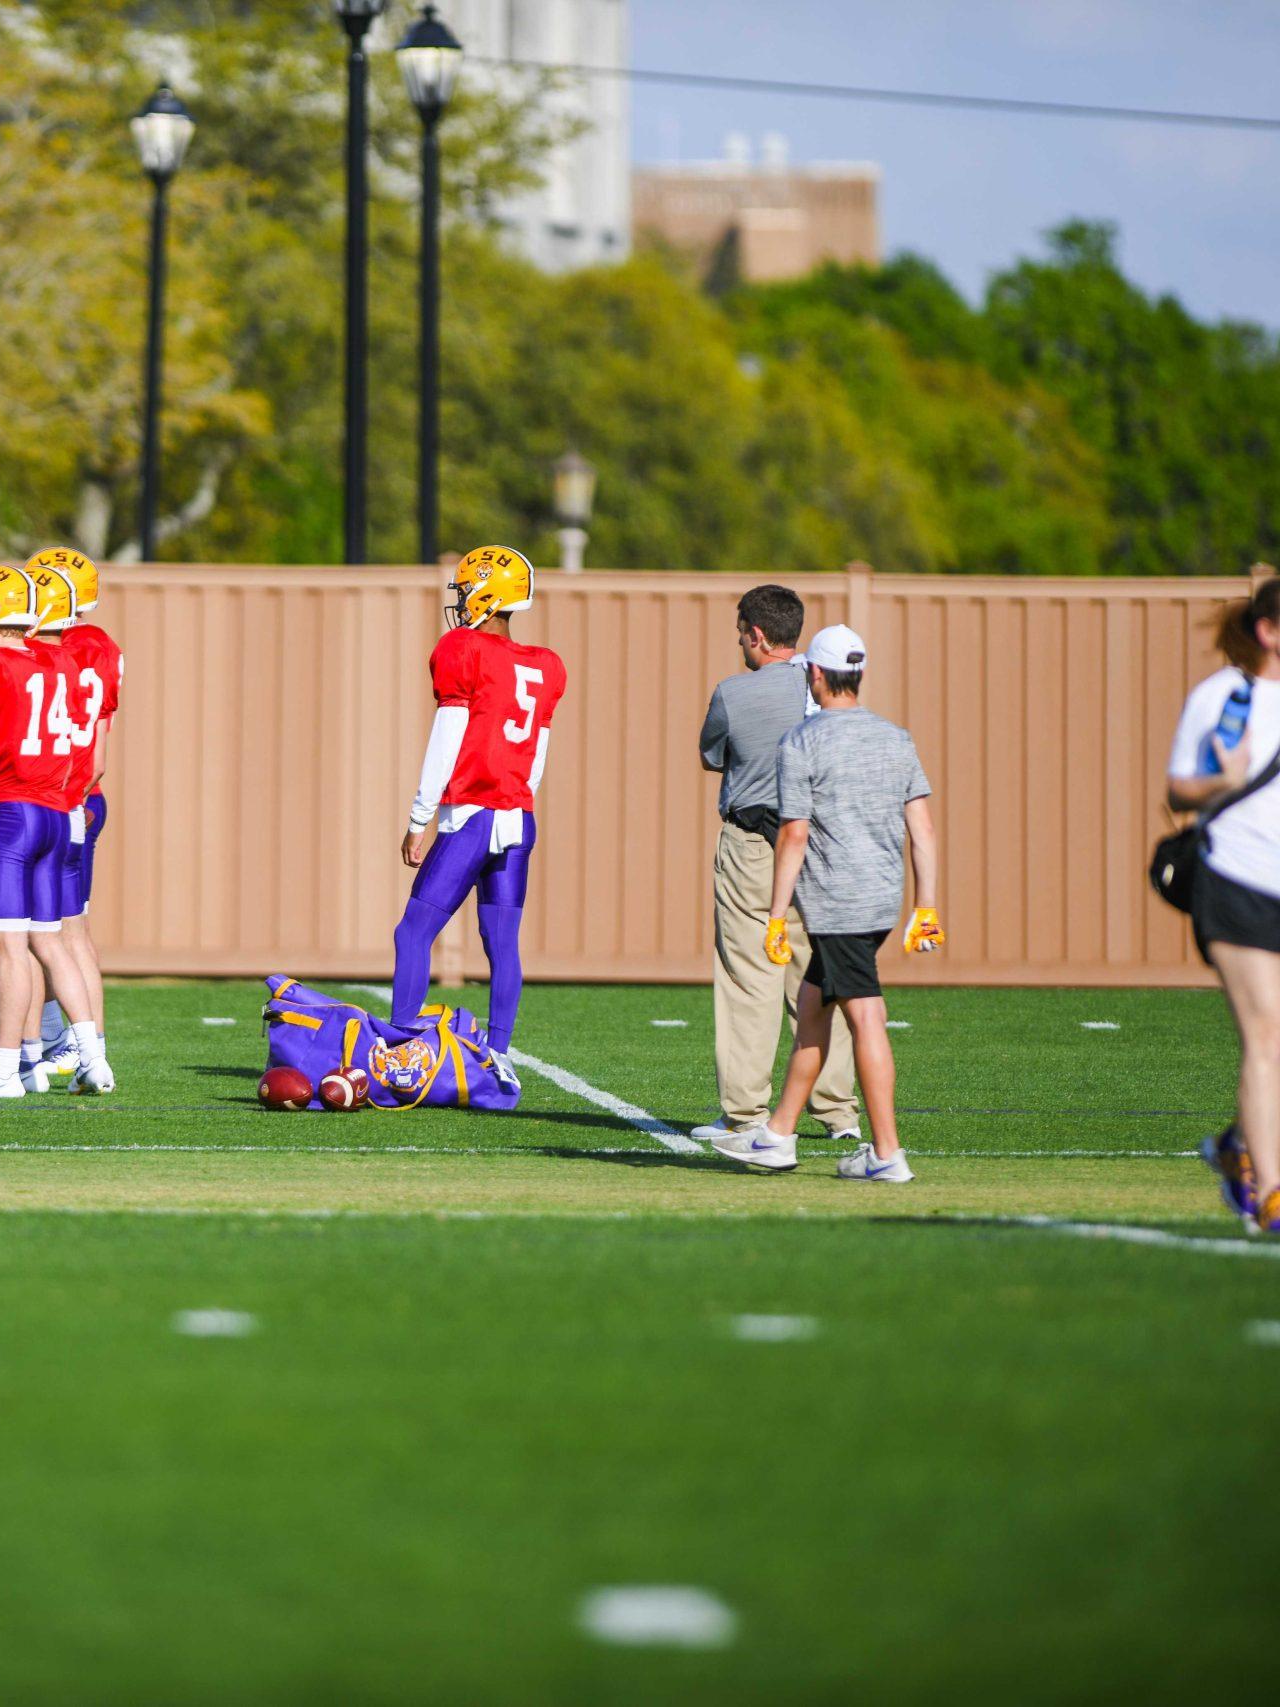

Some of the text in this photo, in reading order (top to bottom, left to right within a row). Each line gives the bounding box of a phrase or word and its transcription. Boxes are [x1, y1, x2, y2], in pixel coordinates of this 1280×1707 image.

[37, 551, 85, 569] LSU
[467, 550, 512, 568] LSU
[20, 672, 73, 756] 14
[503, 663, 544, 744] 5
